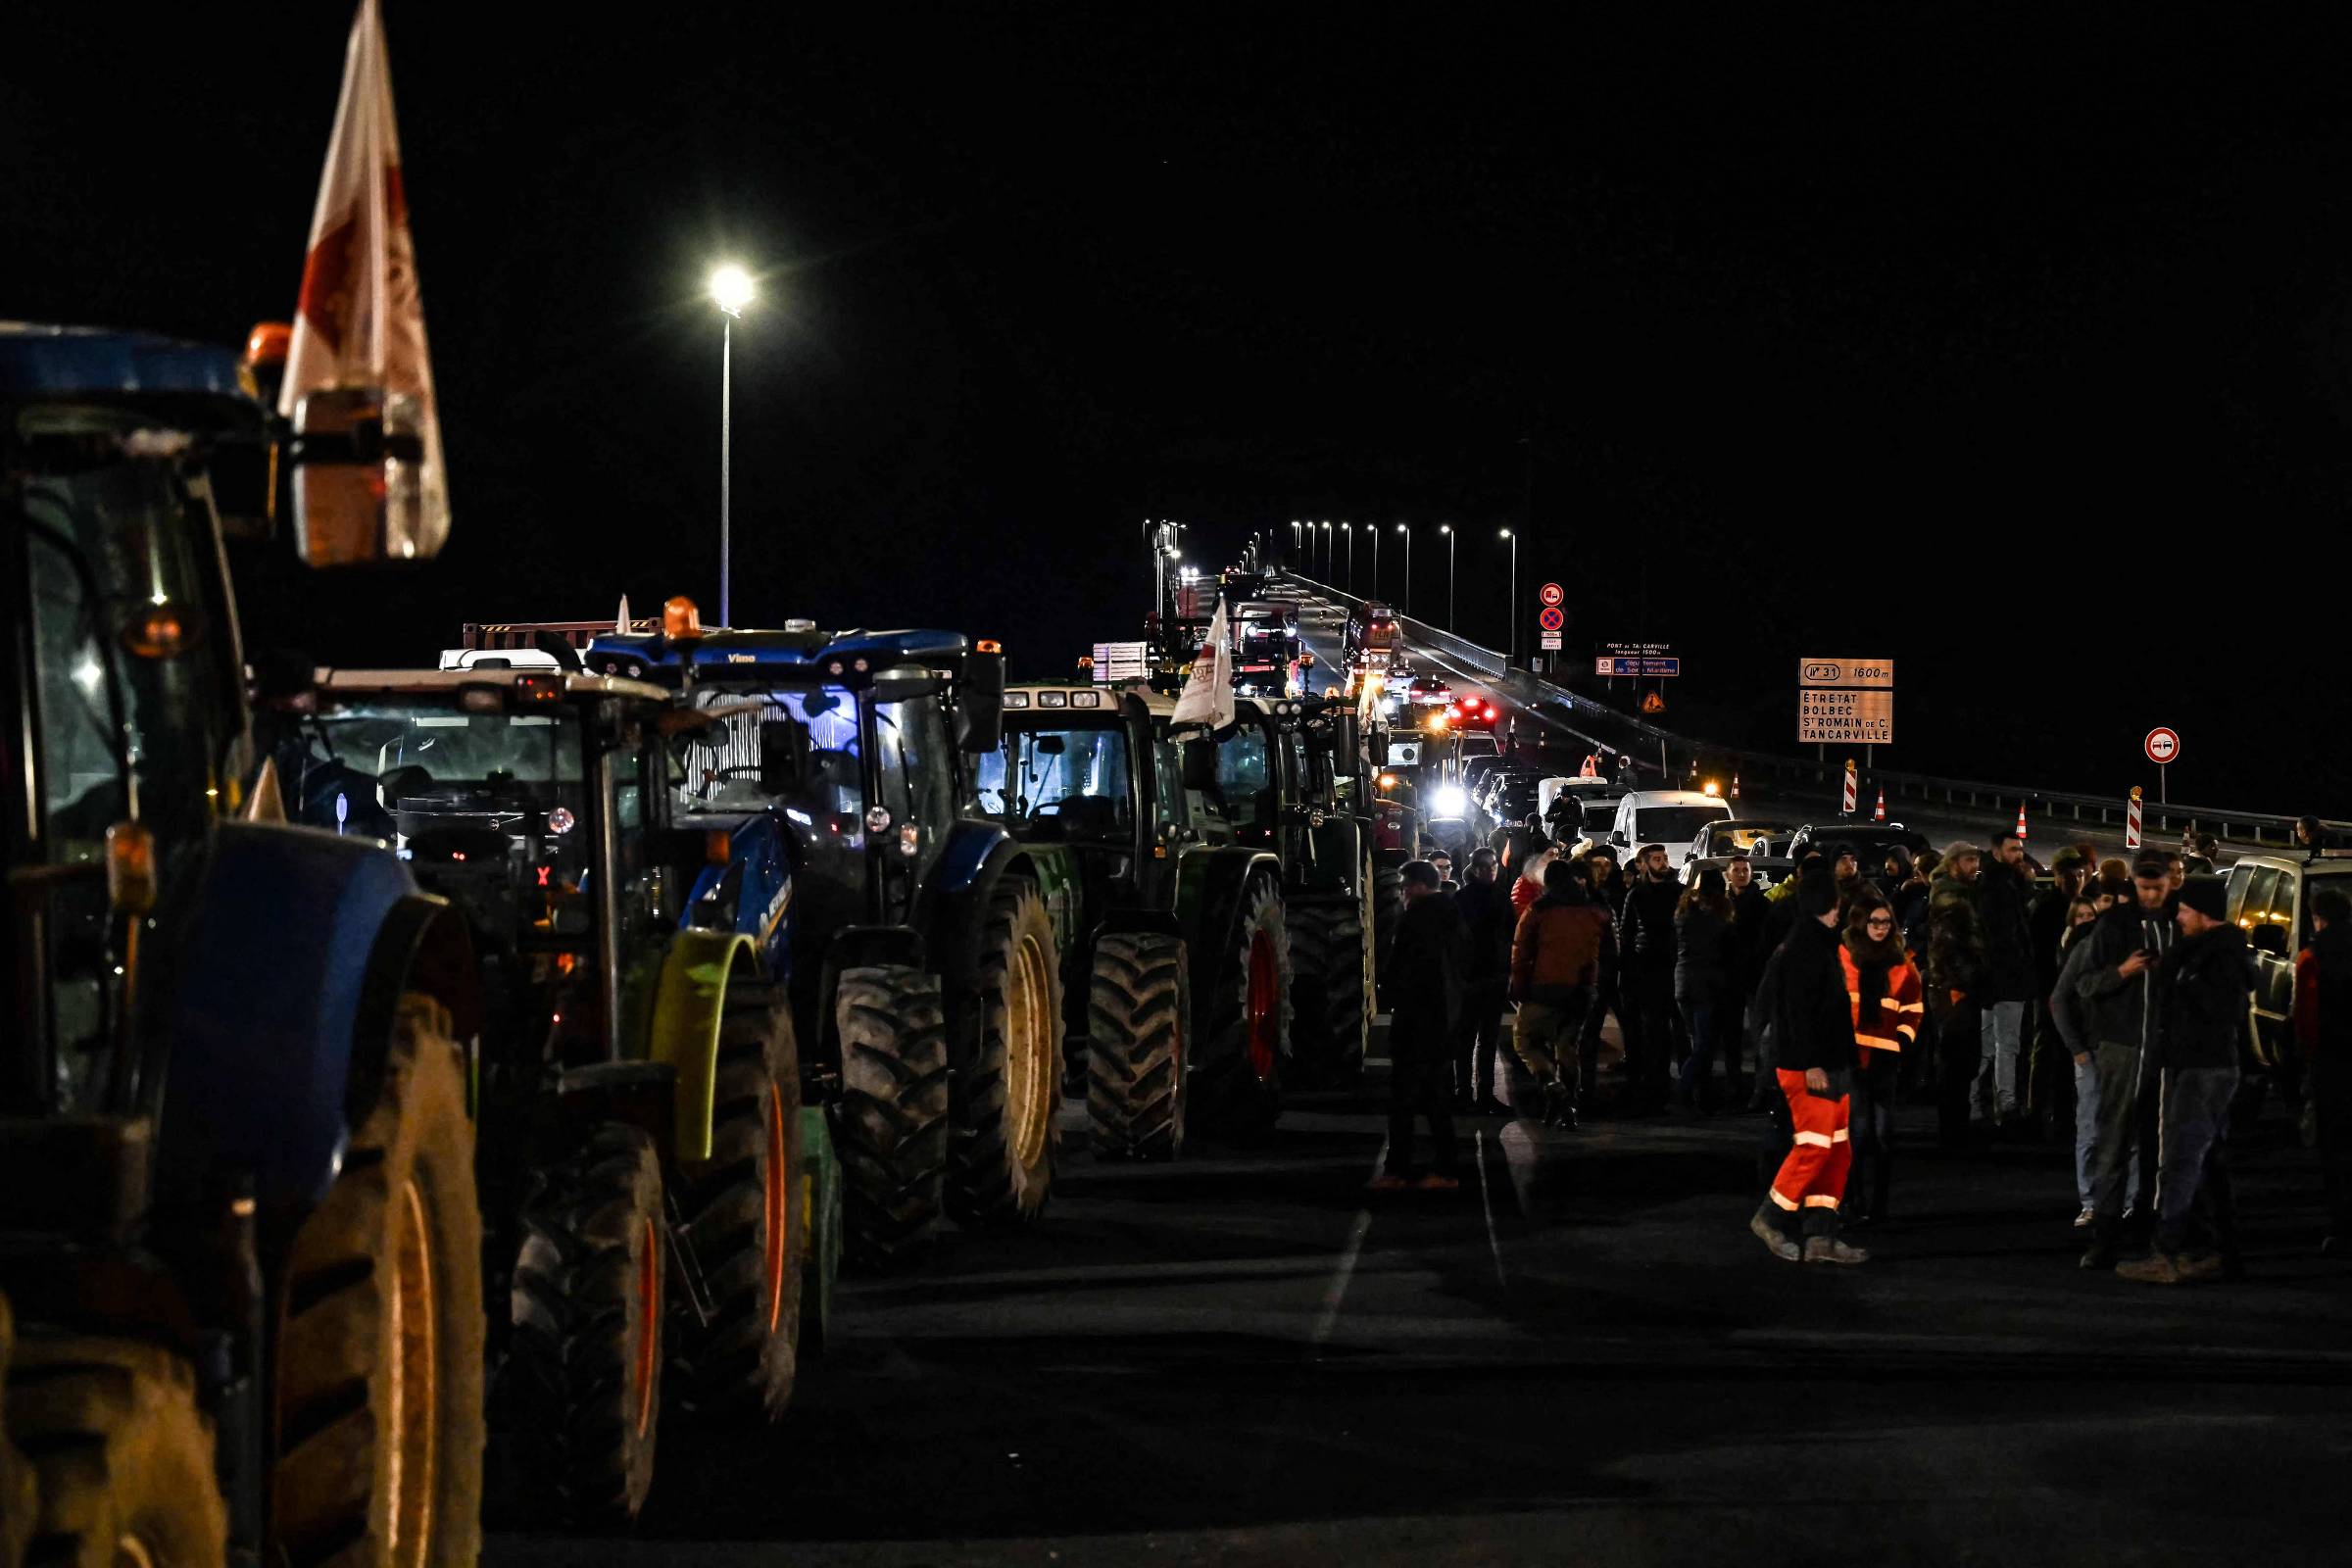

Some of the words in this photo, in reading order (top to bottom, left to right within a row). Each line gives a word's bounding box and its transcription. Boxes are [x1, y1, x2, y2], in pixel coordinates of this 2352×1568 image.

[1823, 667, 1837, 677] 31
[1803, 692, 1857, 704] ÉTRETAT
[1803, 706, 1852, 715] BOLBEC
[1818, 717, 1862, 728] ROMAIN
[1879, 718, 1888, 728] C.
[1803, 729, 1888, 740] TANCARVILLE
